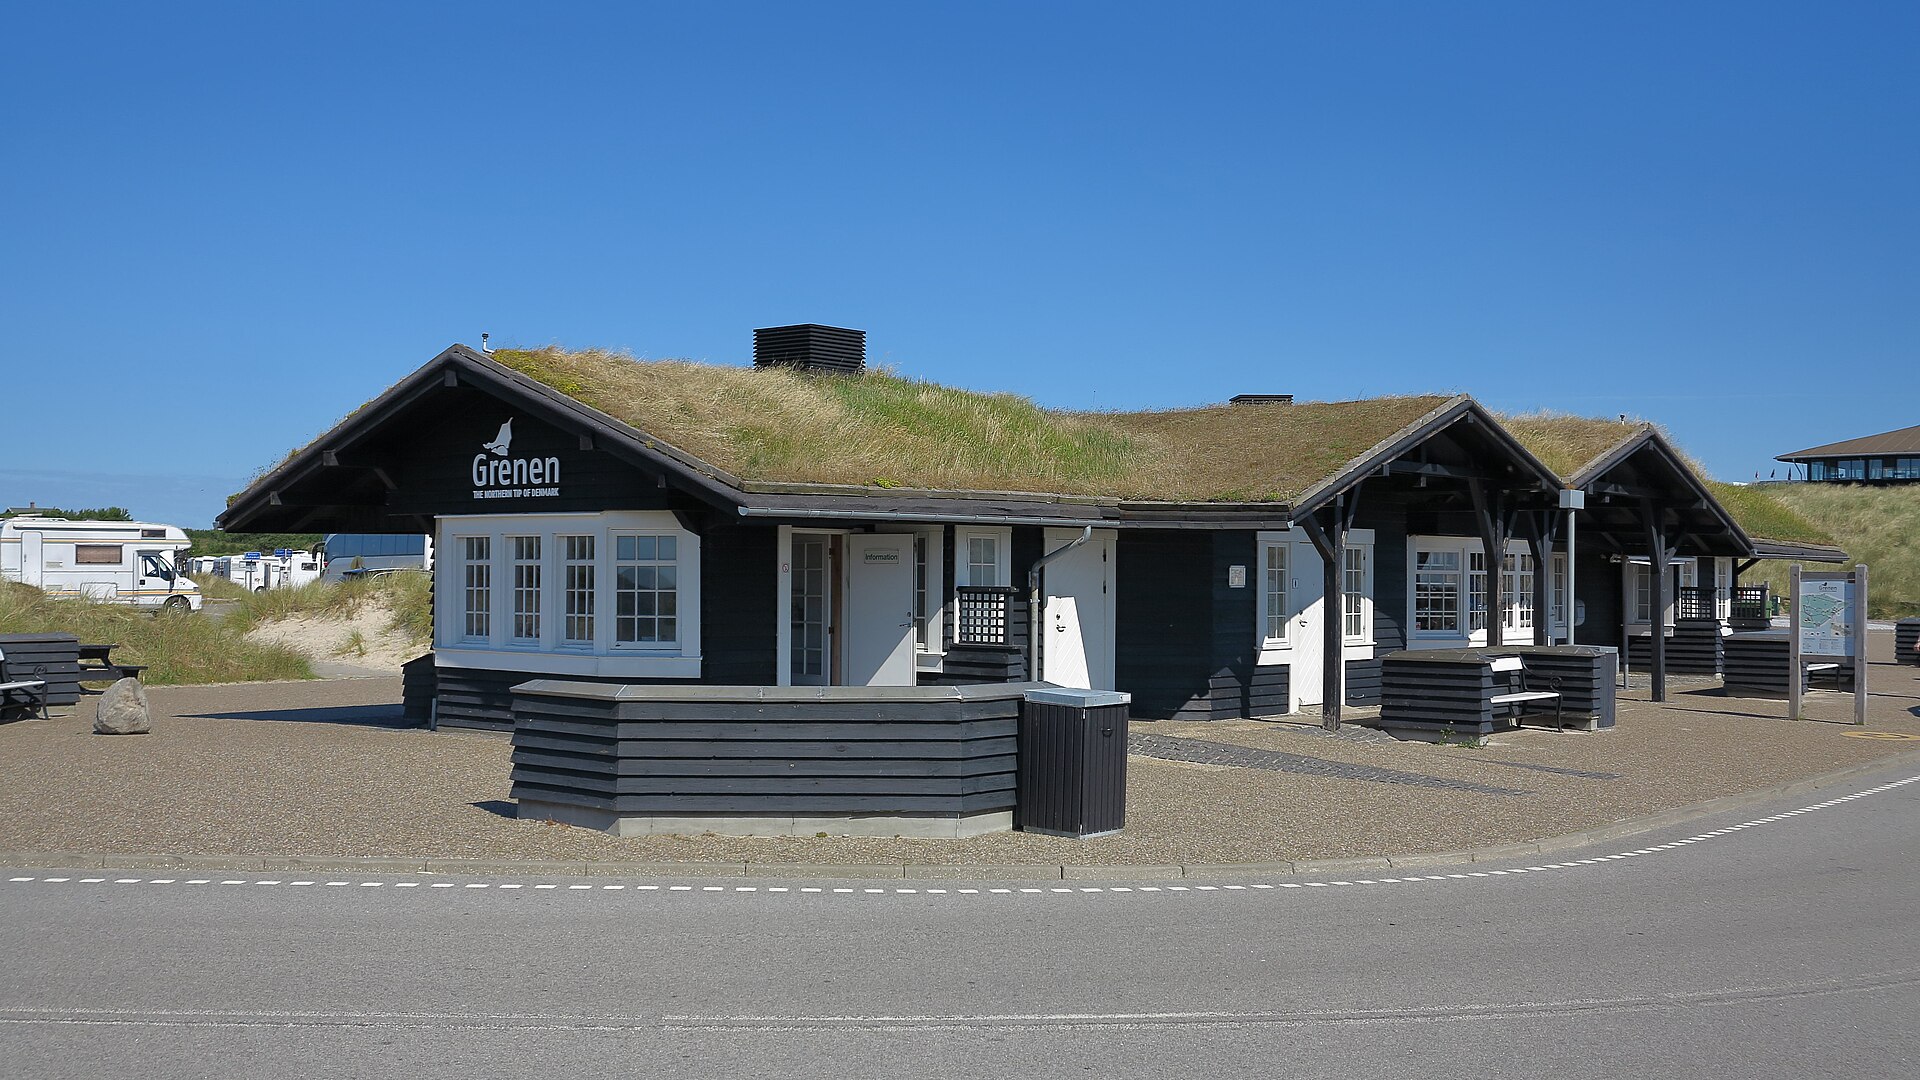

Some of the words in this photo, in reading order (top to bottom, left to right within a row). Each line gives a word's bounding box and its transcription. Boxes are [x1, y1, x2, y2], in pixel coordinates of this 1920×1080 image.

[472, 454, 560, 487] Grenen
[473, 490, 484, 499] THE
[484, 489, 513, 499] NORTHERN
[513, 489, 522, 498] TIP
[523, 488, 531, 497] OF
[531, 487, 560, 497] DENMARK
[865, 553, 898, 561] Information
